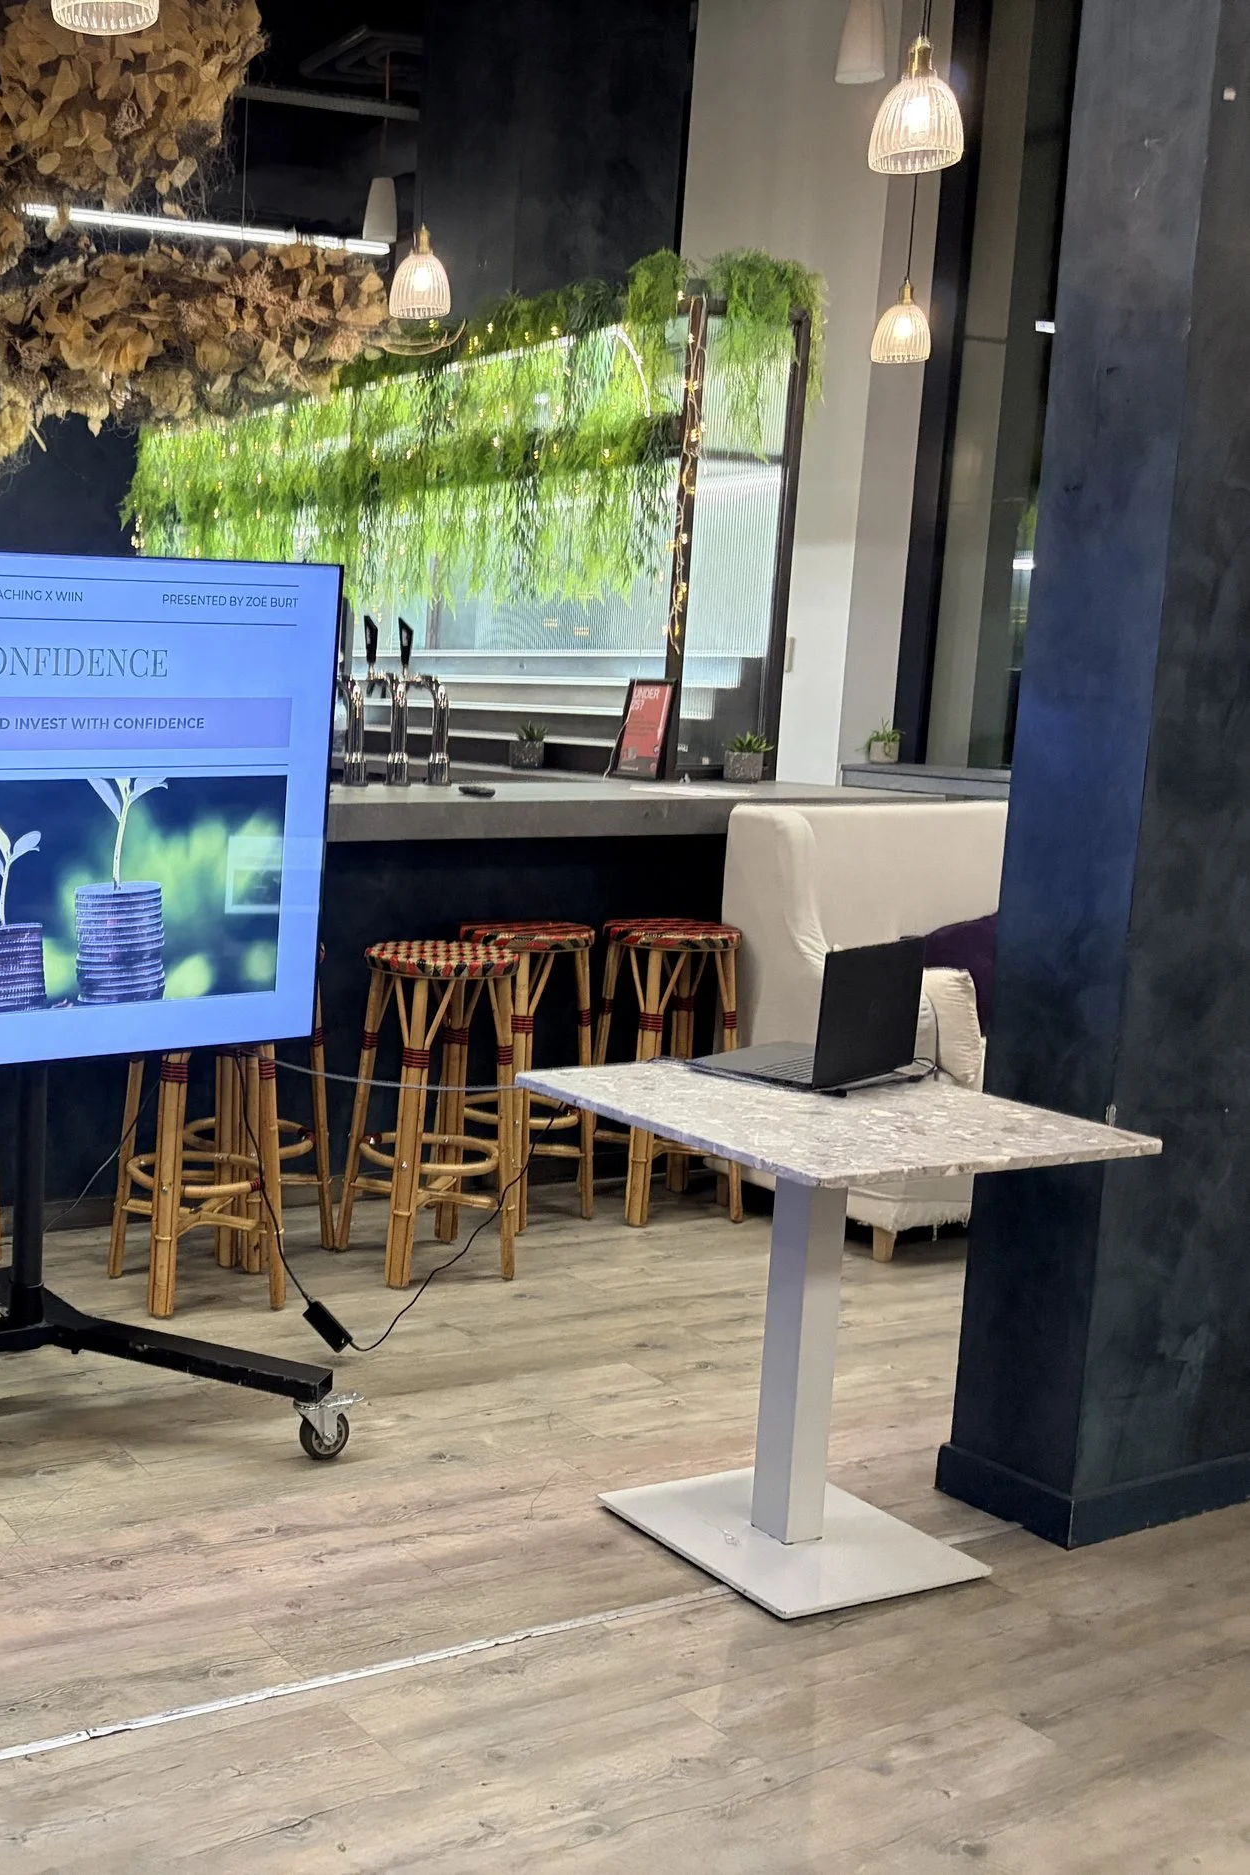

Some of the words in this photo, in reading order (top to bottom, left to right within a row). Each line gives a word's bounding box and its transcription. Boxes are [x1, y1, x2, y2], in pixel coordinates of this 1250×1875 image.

[45, 590, 53, 602] X
[55, 591, 83, 602] WIIN
[162, 593, 227, 606] PRESENTED
[229, 596, 244, 607] BY
[270, 597, 299, 608] BURT
[633, 687, 660, 700] UNDER
[14, 717, 67, 730] INVEST
[71, 717, 110, 730] WITH
[113, 717, 205, 730] CONFIDENCE
